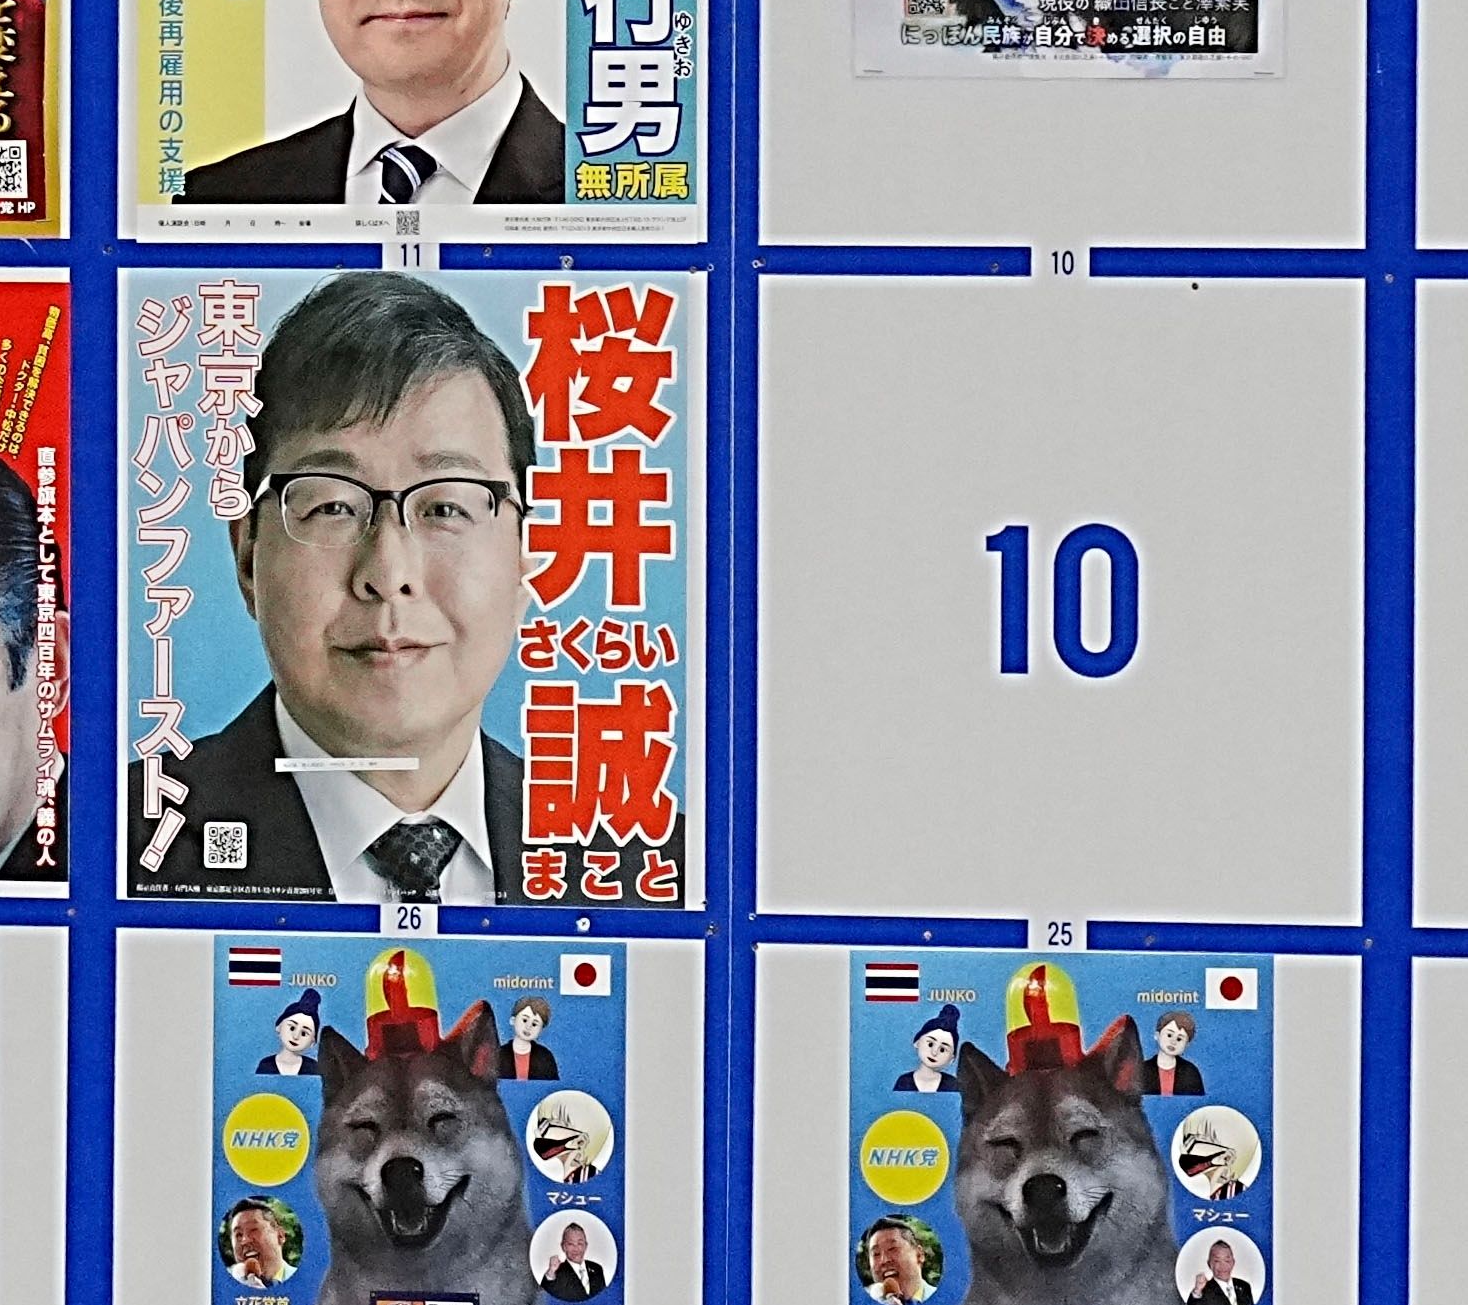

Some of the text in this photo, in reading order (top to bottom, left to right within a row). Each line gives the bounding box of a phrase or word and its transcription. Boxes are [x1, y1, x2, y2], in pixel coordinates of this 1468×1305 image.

[674, 13, 693, 77] ゆきお
[18, 202, 35, 213] HP
[575, 163, 689, 199] 無所属
[196, 279, 263, 520] 東京から
[520, 279, 676, 611] 桜井
[132, 295, 193, 873] ジャパンファースト！
[987, 524, 1138, 677] 10
[517, 616, 678, 674] さくらい
[522, 676, 678, 846] 誠
[521, 847, 678, 900] まこと
[397, 907, 421, 930] 26
[1048, 922, 1072, 945] 25
[869, 1148, 940, 1167] NHK党
[1193, 1209, 1249, 1222] マシュー
